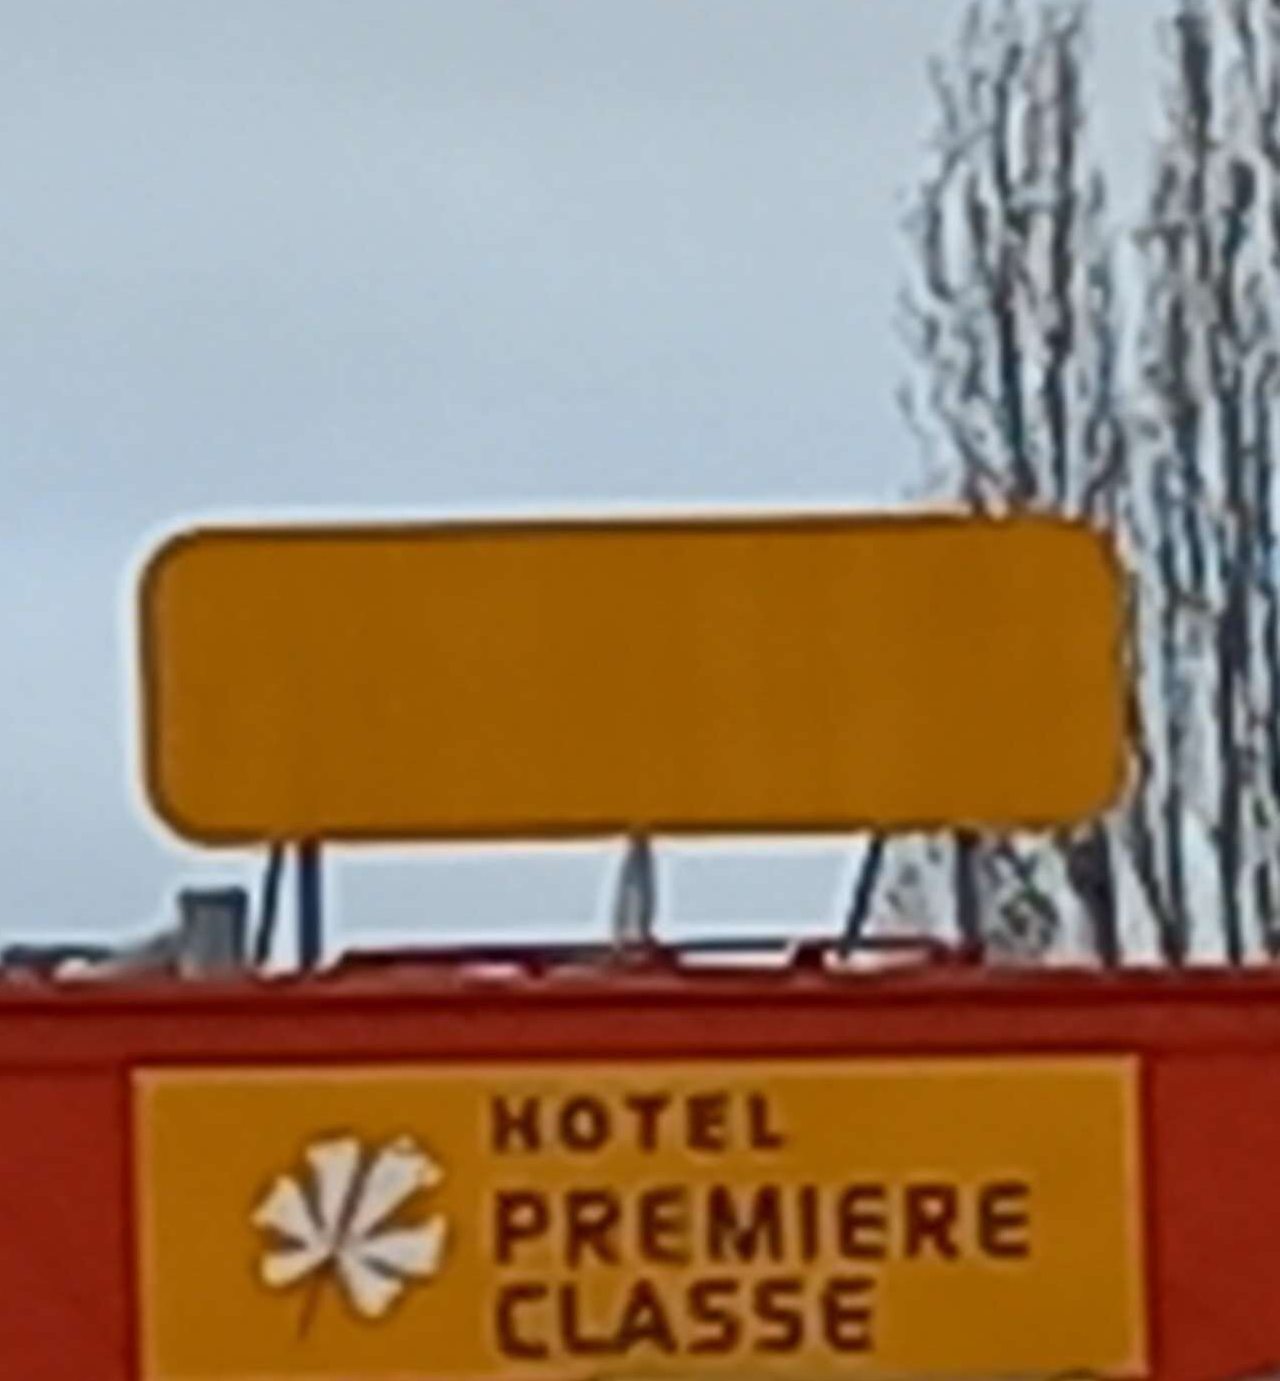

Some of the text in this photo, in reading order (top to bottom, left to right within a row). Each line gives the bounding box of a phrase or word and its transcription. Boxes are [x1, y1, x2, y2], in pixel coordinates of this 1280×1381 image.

[491, 1092, 786, 1153] HOTEL
[493, 1182, 1030, 1267] PREMIERE
[494, 1277, 875, 1359] CLASSE
